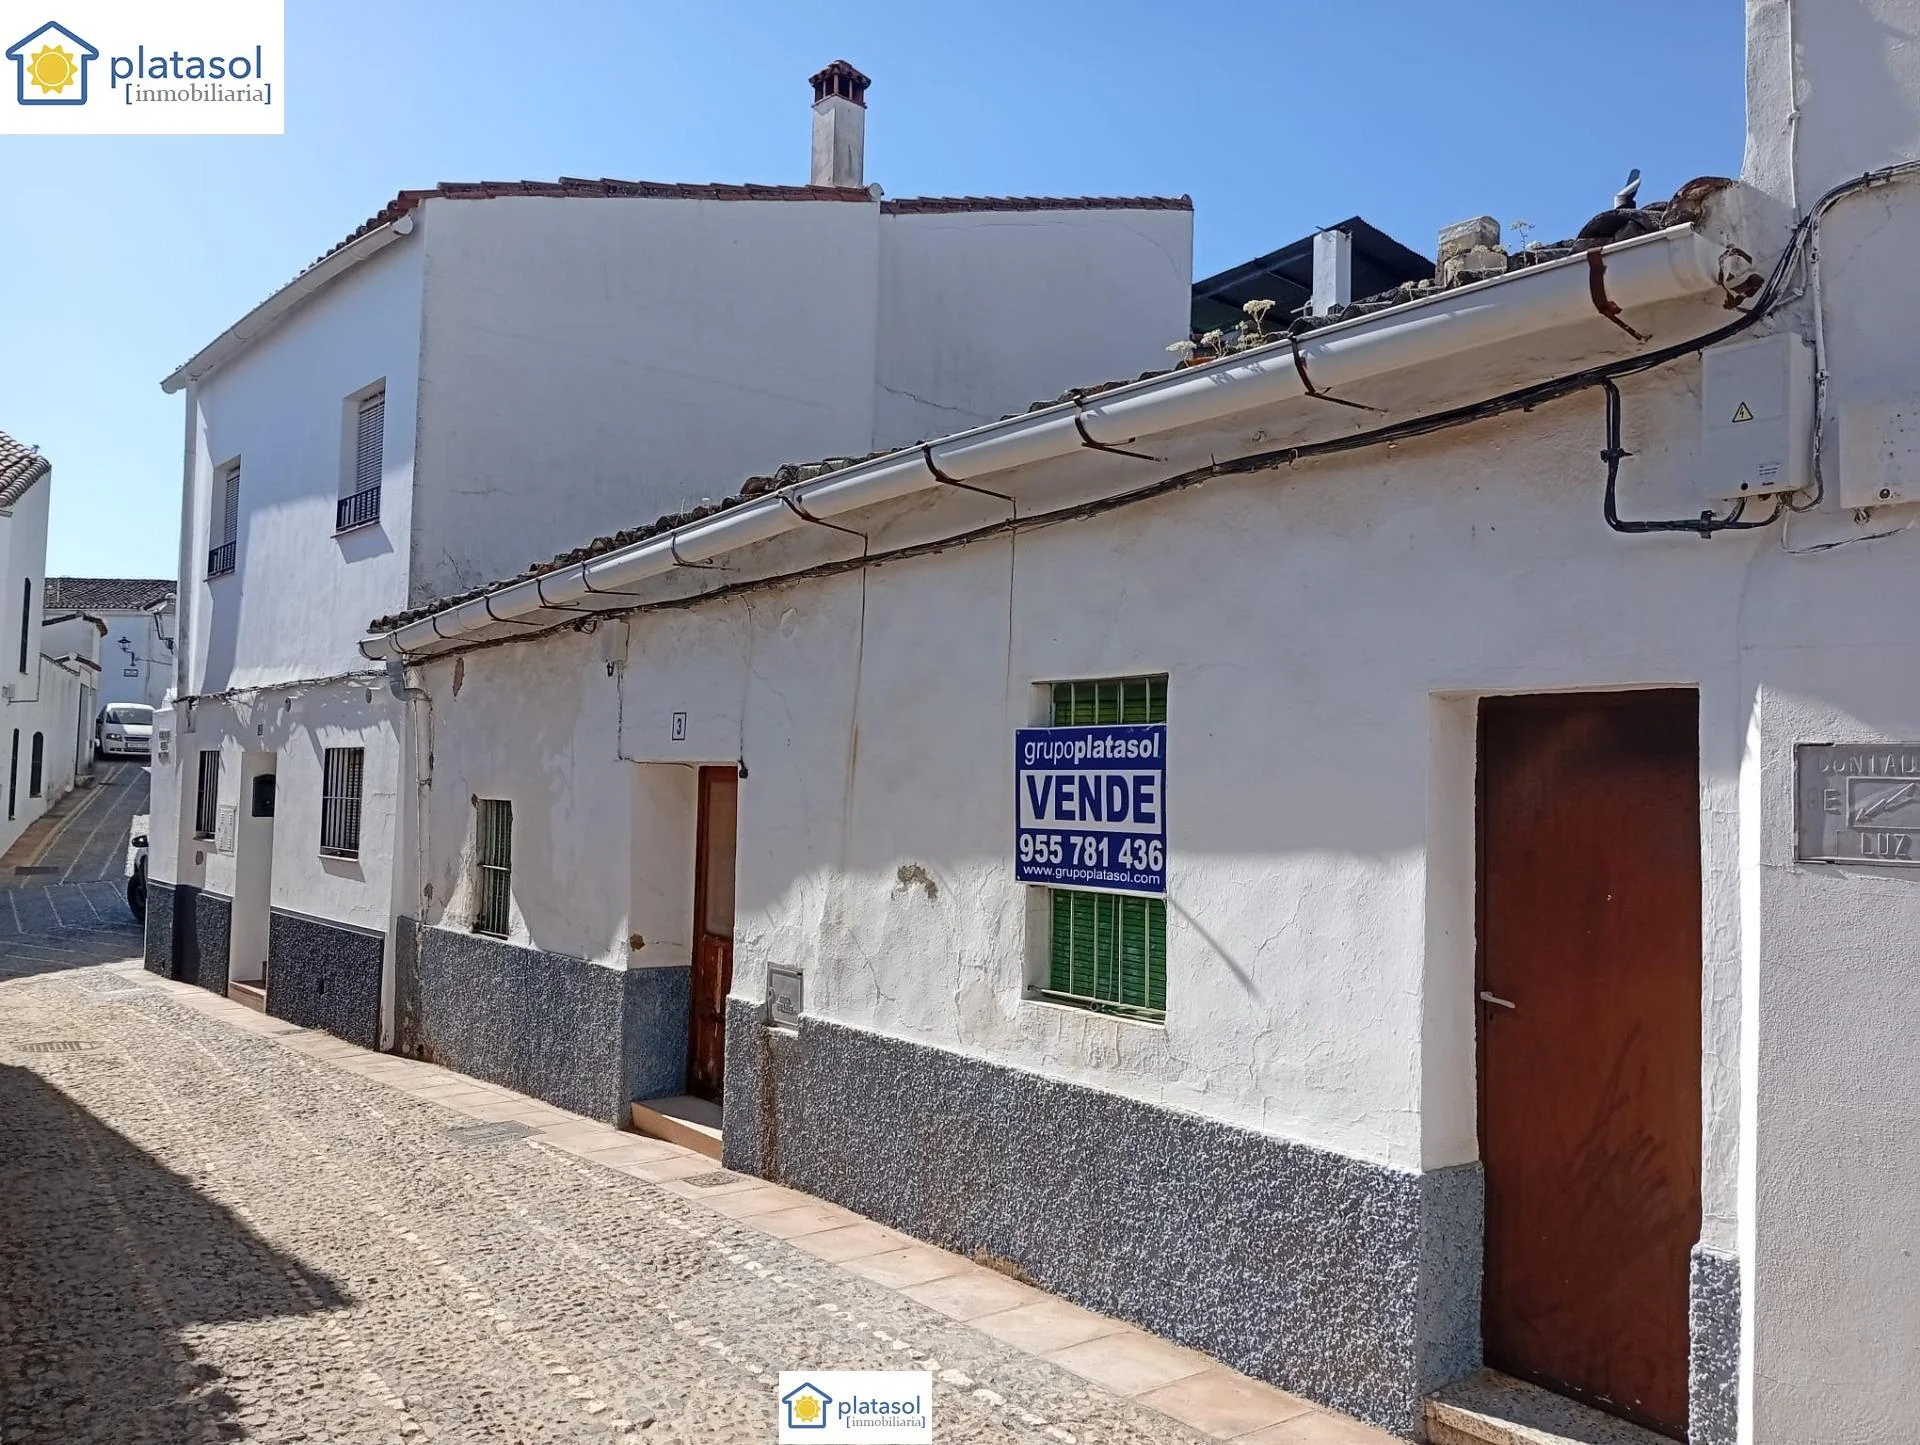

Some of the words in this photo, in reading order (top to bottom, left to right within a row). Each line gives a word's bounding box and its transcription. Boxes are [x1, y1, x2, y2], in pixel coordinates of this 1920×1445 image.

[676, 718, 682, 735] 3
[1024, 733, 1160, 766] grupoplatasol
[1026, 775, 1156, 824] VENDE
[1019, 834, 1063, 864] 955
[1070, 836, 1109, 868] 781
[1118, 838, 1163, 872] 436
[1860, 831, 1909, 857] LUZ
[1023, 865, 1161, 886] www.grupoplatasol.com
